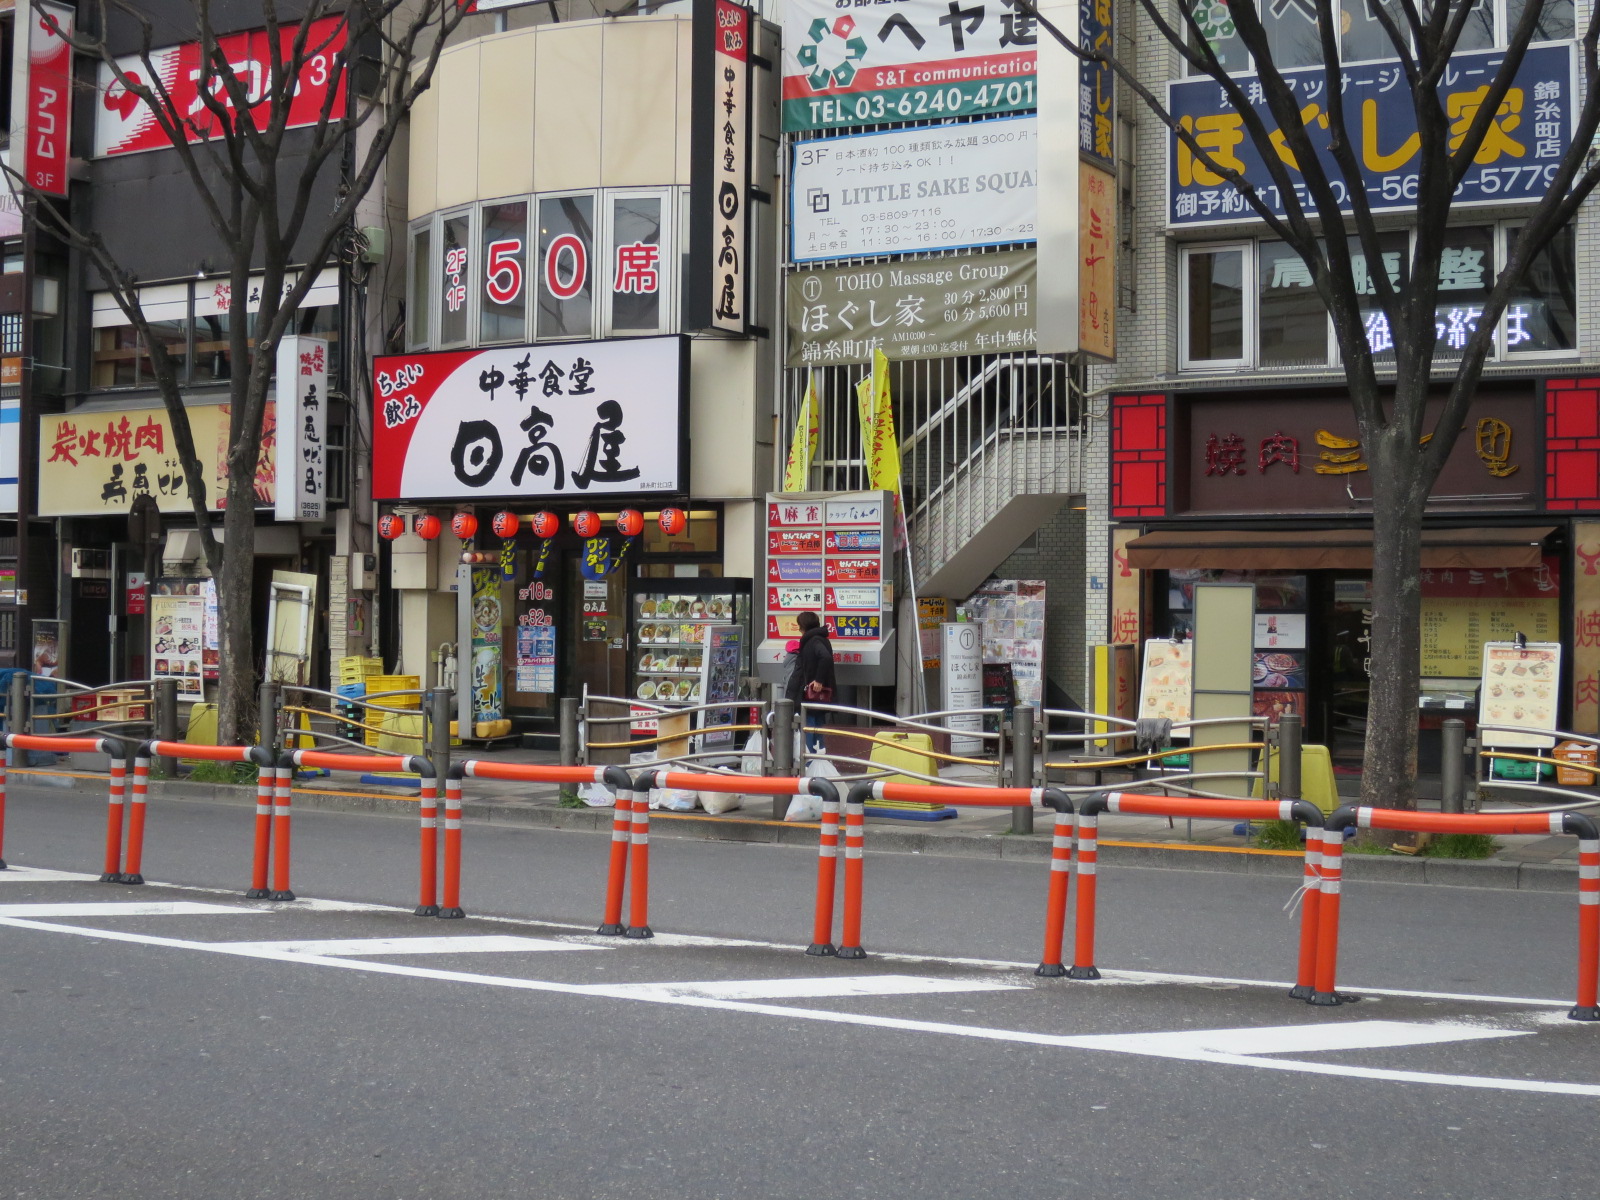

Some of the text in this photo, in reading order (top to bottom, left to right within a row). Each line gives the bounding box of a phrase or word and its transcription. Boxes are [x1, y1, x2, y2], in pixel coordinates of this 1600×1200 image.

[717, 8, 741, 27] ちょい
[724, 30, 743, 51] 飲み
[876, 69, 906, 86] S&T
[1079, 0, 1092, 151] こり・腰痛
[809, 80, 1033, 124] TEL.03-6240-4701
[38, 86, 57, 159] アコム
[723, 65, 736, 172] 中華食堂
[1534, 80, 1561, 158] 錦糸町店
[801, 149, 829, 166] 3F
[884, 144, 905, 155] 100
[981, 132, 1015, 145] 3000
[1018, 130, 1029, 142] 円
[836, 159, 913, 176] フード持ち込み
[36, 172, 54, 187] 3F
[841, 170, 1037, 206] LITTLE SAKE SQUA
[820, 207, 942, 226] TEL 03-5809-7116
[715, 180, 740, 321] 日高屋
[809, 239, 848, 252] 土日祭日
[836, 264, 1009, 292] TOHO Massage Group
[944, 284, 1028, 305] 30 分 2,800 円
[801, 294, 926, 333] ほぐし家
[944, 301, 1028, 322] 60 分 5,600 円
[891, 330, 926, 342] AM10:00
[974, 328, 1037, 349] 年中無休
[1366, 305, 1530, 354] 御約は
[801, 336, 884, 362] 錦糸町店
[921, 344, 938, 354] 4:00
[300, 352, 313, 376] 焼肉
[377, 363, 424, 397] ちょい
[479, 353, 595, 402] 中華食堂
[384, 395, 421, 428] 飲み
[47, 415, 165, 467] 炭火焼肉
[451, 400, 641, 490] 日高屋
[1204, 416, 1519, 477] 焼肉 三里
[770, 510, 779, 520] 7F
[784, 505, 819, 523] 麻雀
[770, 539, 779, 549] 5F
[826, 537, 836, 548] 6F
[826, 566, 836, 576] 5F
[583, 601, 607, 612] 日高屋
[769, 594, 779, 604] 3F
[794, 593, 821, 602] ヘヤ選
[826, 594, 836, 604] 3F
[769, 623, 778, 632] 1F
[837, 616, 879, 628] ほぐし家
[844, 628, 873, 636] 錦糸町店
[472, 665, 487, 692] 生
[473, 691, 500, 713] ビール
